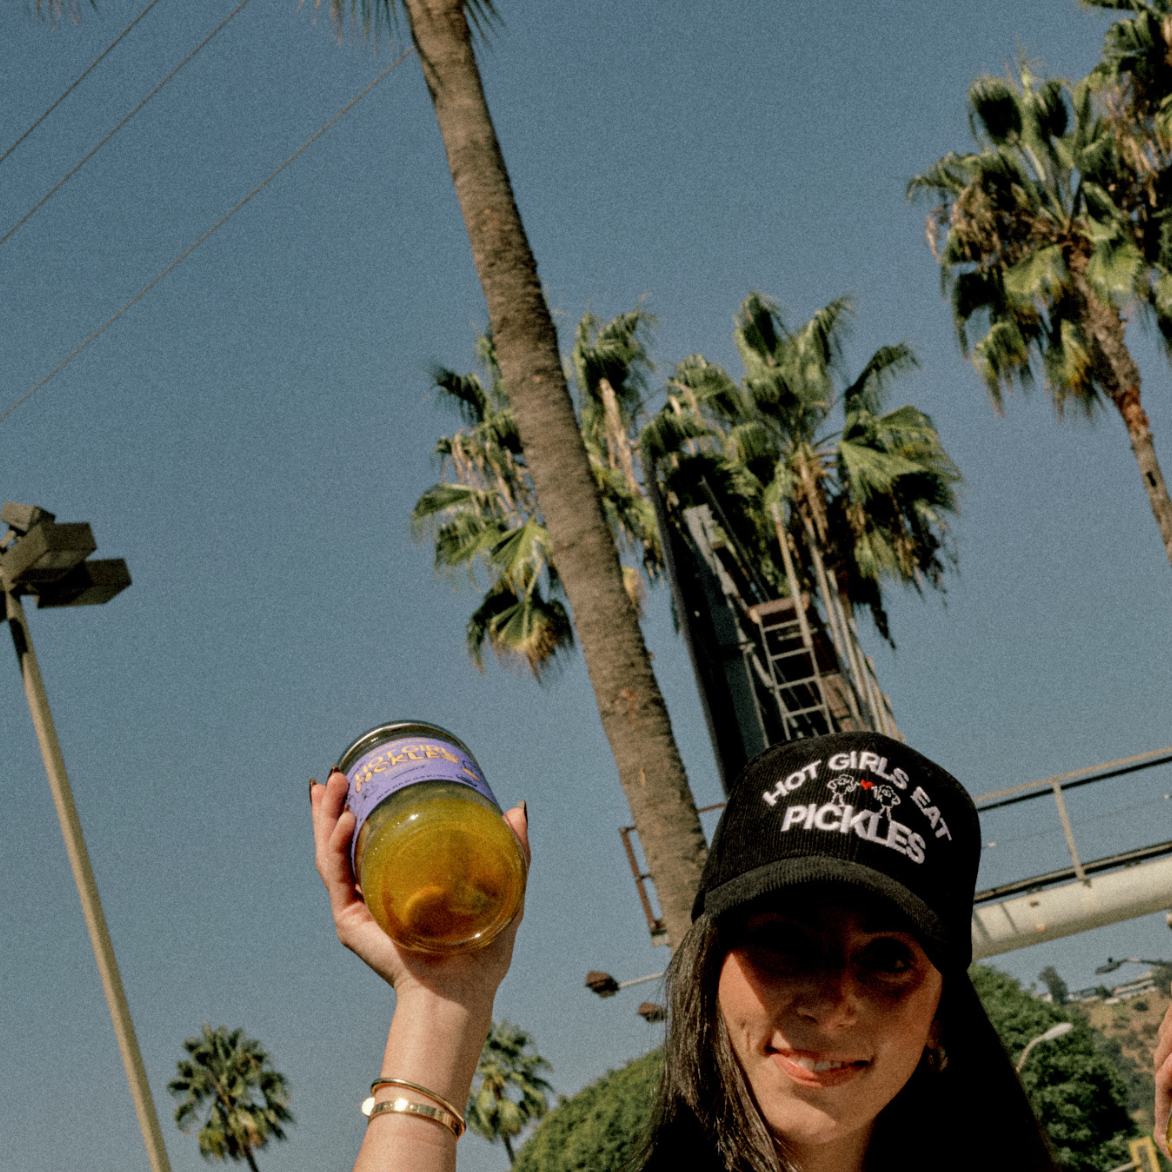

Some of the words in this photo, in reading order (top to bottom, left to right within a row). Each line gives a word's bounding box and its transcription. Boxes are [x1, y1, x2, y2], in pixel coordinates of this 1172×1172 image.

[354, 749, 397, 782] HOT
[401, 744, 449, 755] GIRL
[355, 750, 459, 793] PICKLES
[762, 759, 822, 806] HOT
[827, 750, 910, 790] GIRLS
[910, 786, 952, 841] EAT
[780, 803, 926, 865] PICKLES
